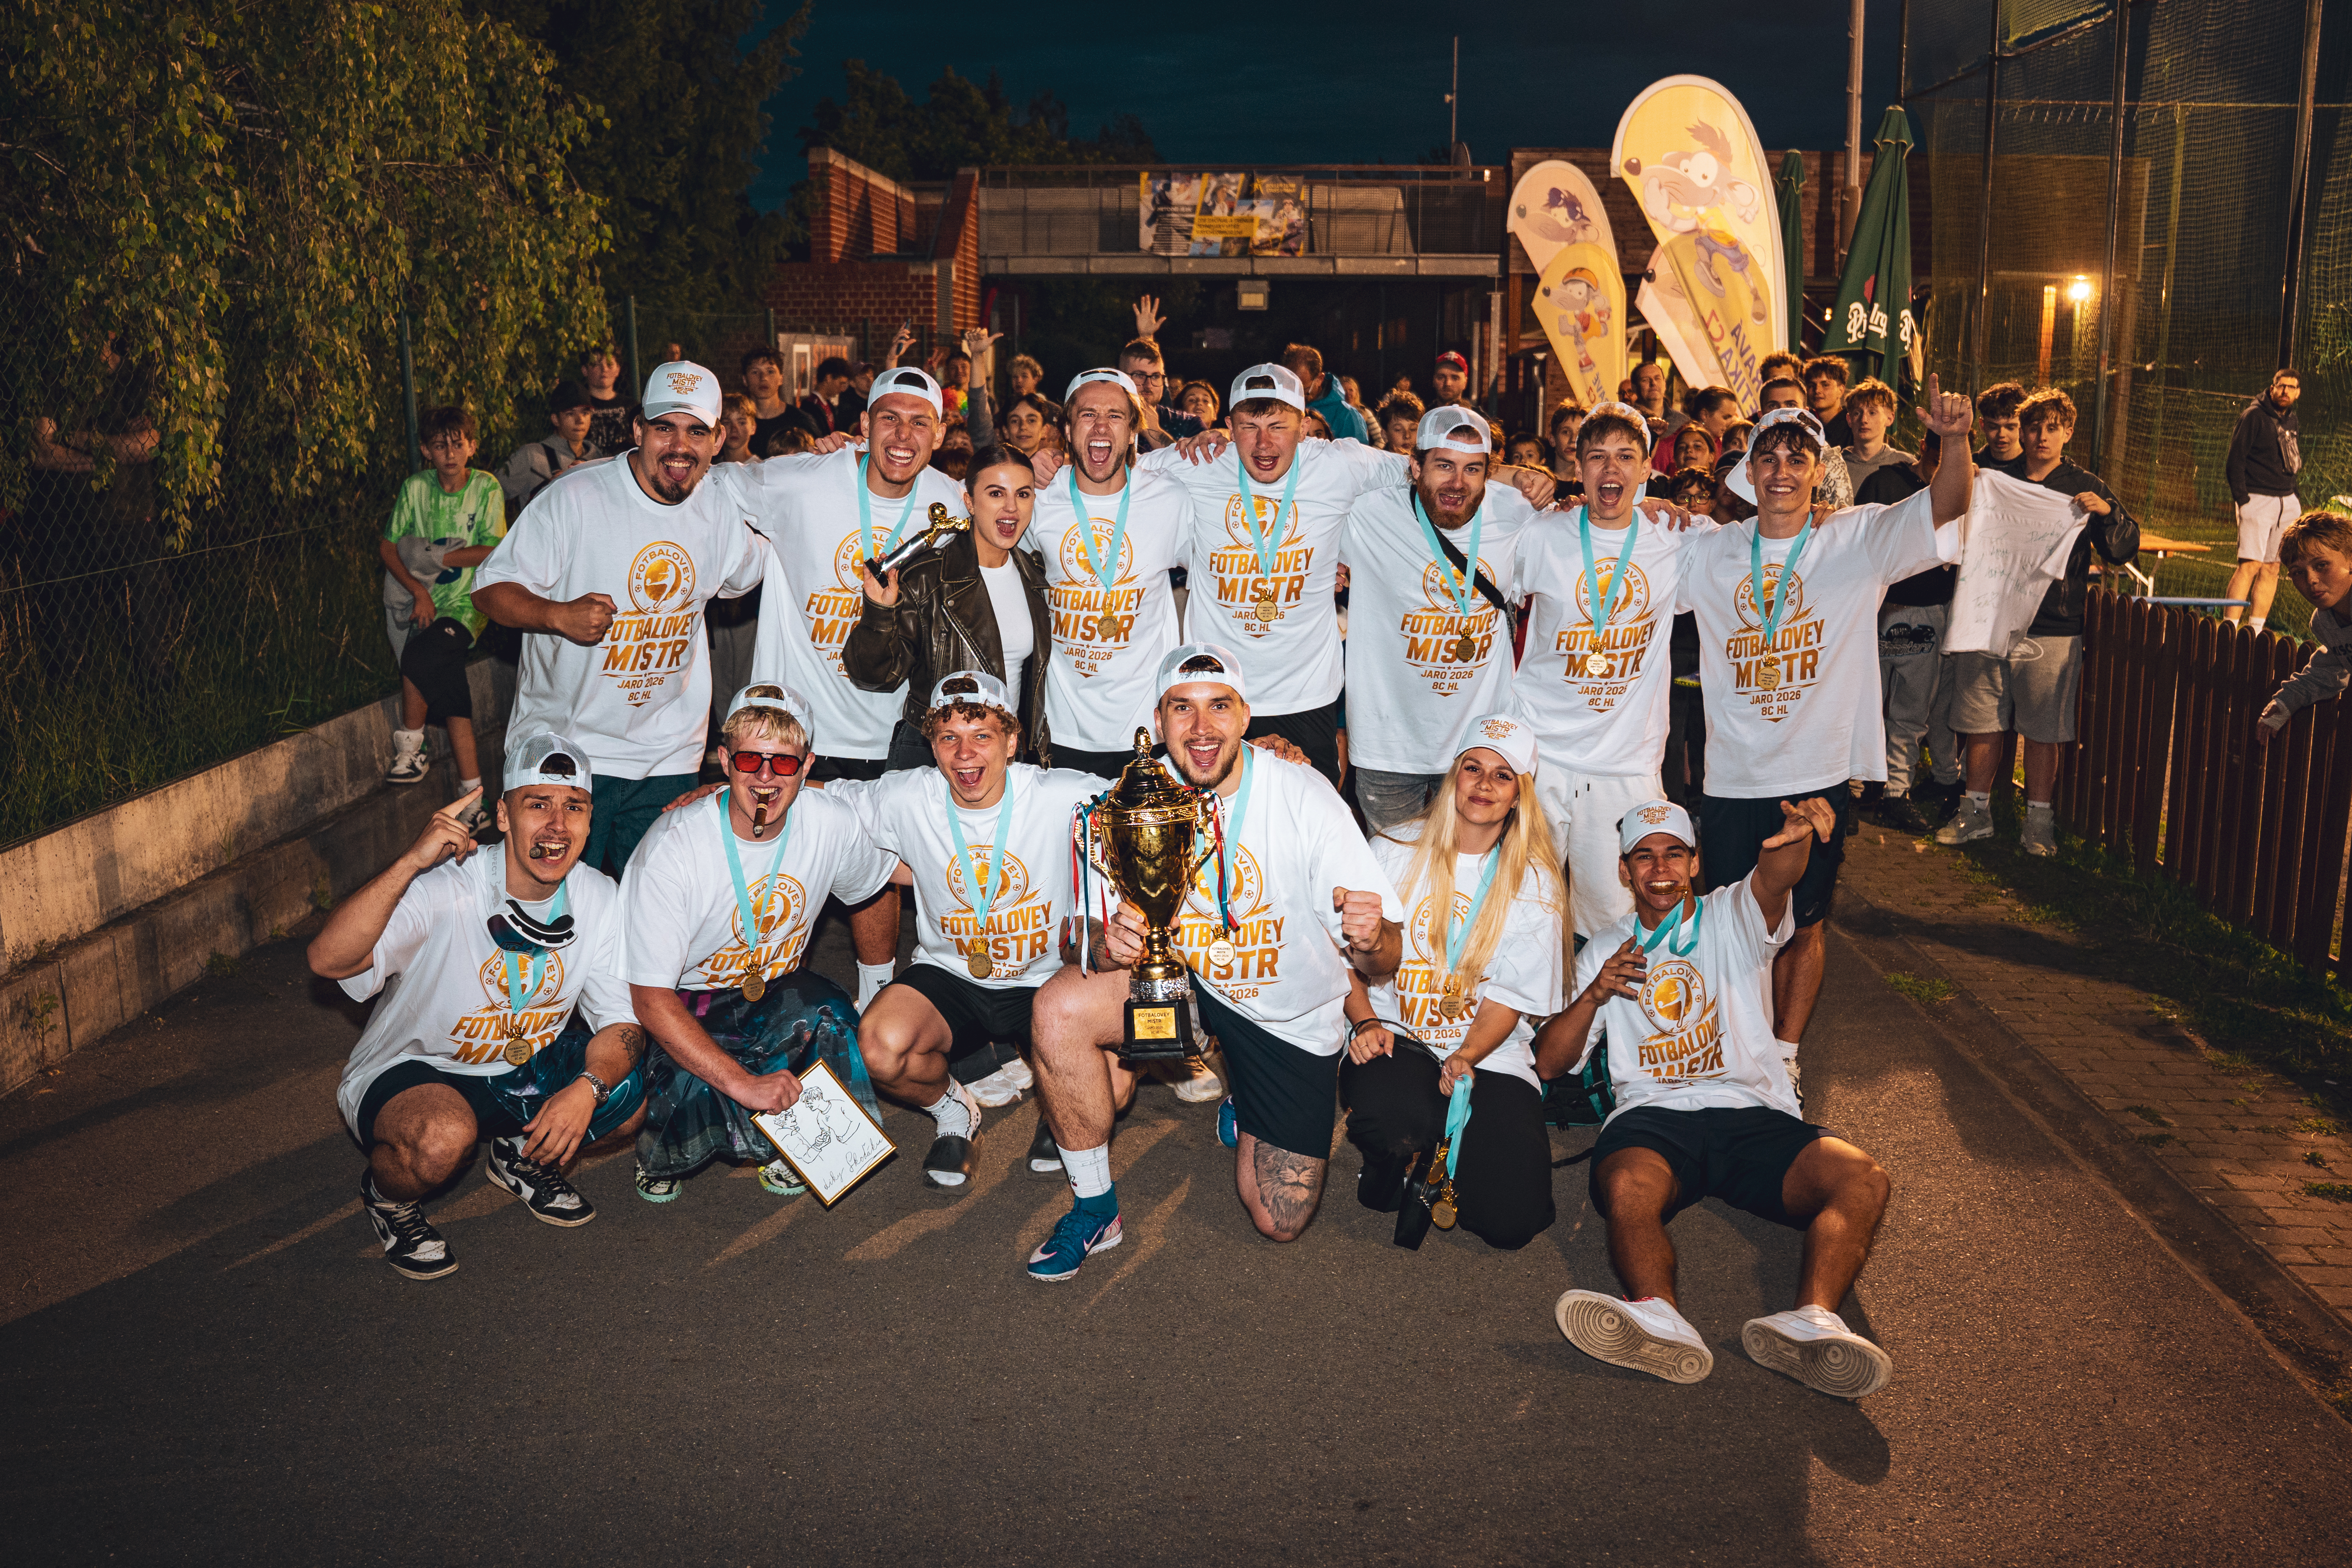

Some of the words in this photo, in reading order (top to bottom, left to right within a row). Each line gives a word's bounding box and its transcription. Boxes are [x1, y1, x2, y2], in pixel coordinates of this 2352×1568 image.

[667, 373, 703, 381] FOTBALOVEY
[635, 549, 690, 583] FOTBALOVEY
[1209, 547, 1314, 575] FOTBAOVEY
[602, 639, 689, 672] MISTR
[1064, 647, 1086, 657] JARO
[1089, 651, 1112, 660] 2026
[1088, 663, 1098, 672] HL
[1421, 670, 1447, 679] JARO
[1449, 670, 1473, 679] 2026
[618, 680, 642, 689] JARO
[645, 677, 664, 687] 2026
[642, 690, 651, 699] HL
[1578, 686, 1603, 695] JARO
[1750, 694, 1773, 705] JARO
[1776, 690, 1801, 702] 2026
[1777, 705, 1788, 714] HL
[1480, 720, 1518, 730] FOTBALOVEY
[1485, 725, 1509, 733] MISTR
[1637, 806, 1671, 817] FOTBALOVEY
[1644, 811, 1666, 819] MISTR
[971, 954, 989, 964] FOTBALOVEY
[1645, 968, 1700, 1005] FOTBALOVEY
[1229, 988, 1258, 1000] 2026
[1434, 1028, 1461, 1039] 2026
